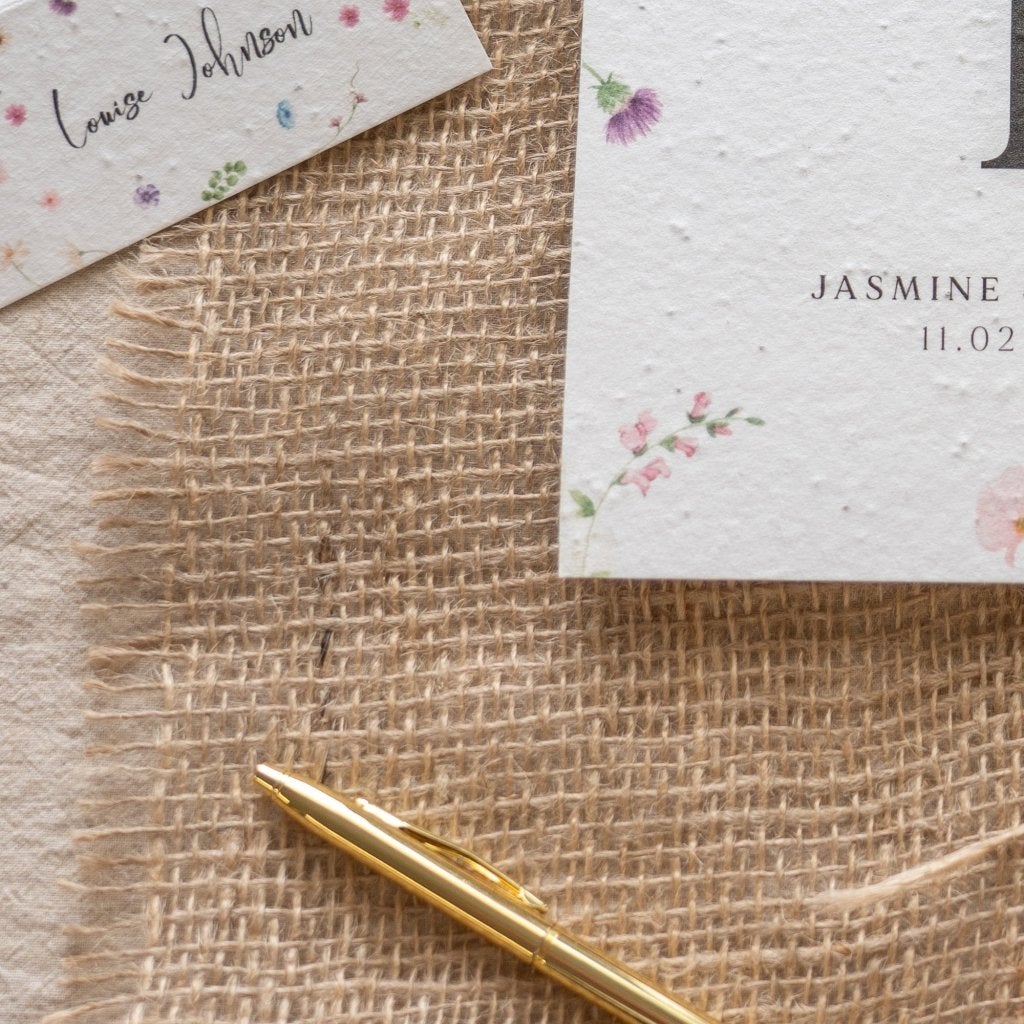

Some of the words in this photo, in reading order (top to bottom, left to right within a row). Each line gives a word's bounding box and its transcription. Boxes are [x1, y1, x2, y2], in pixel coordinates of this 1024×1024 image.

[51, 88, 154, 149] Louise
[163, 6, 314, 101] Johnson
[810, 274, 1001, 303] JASMINE
